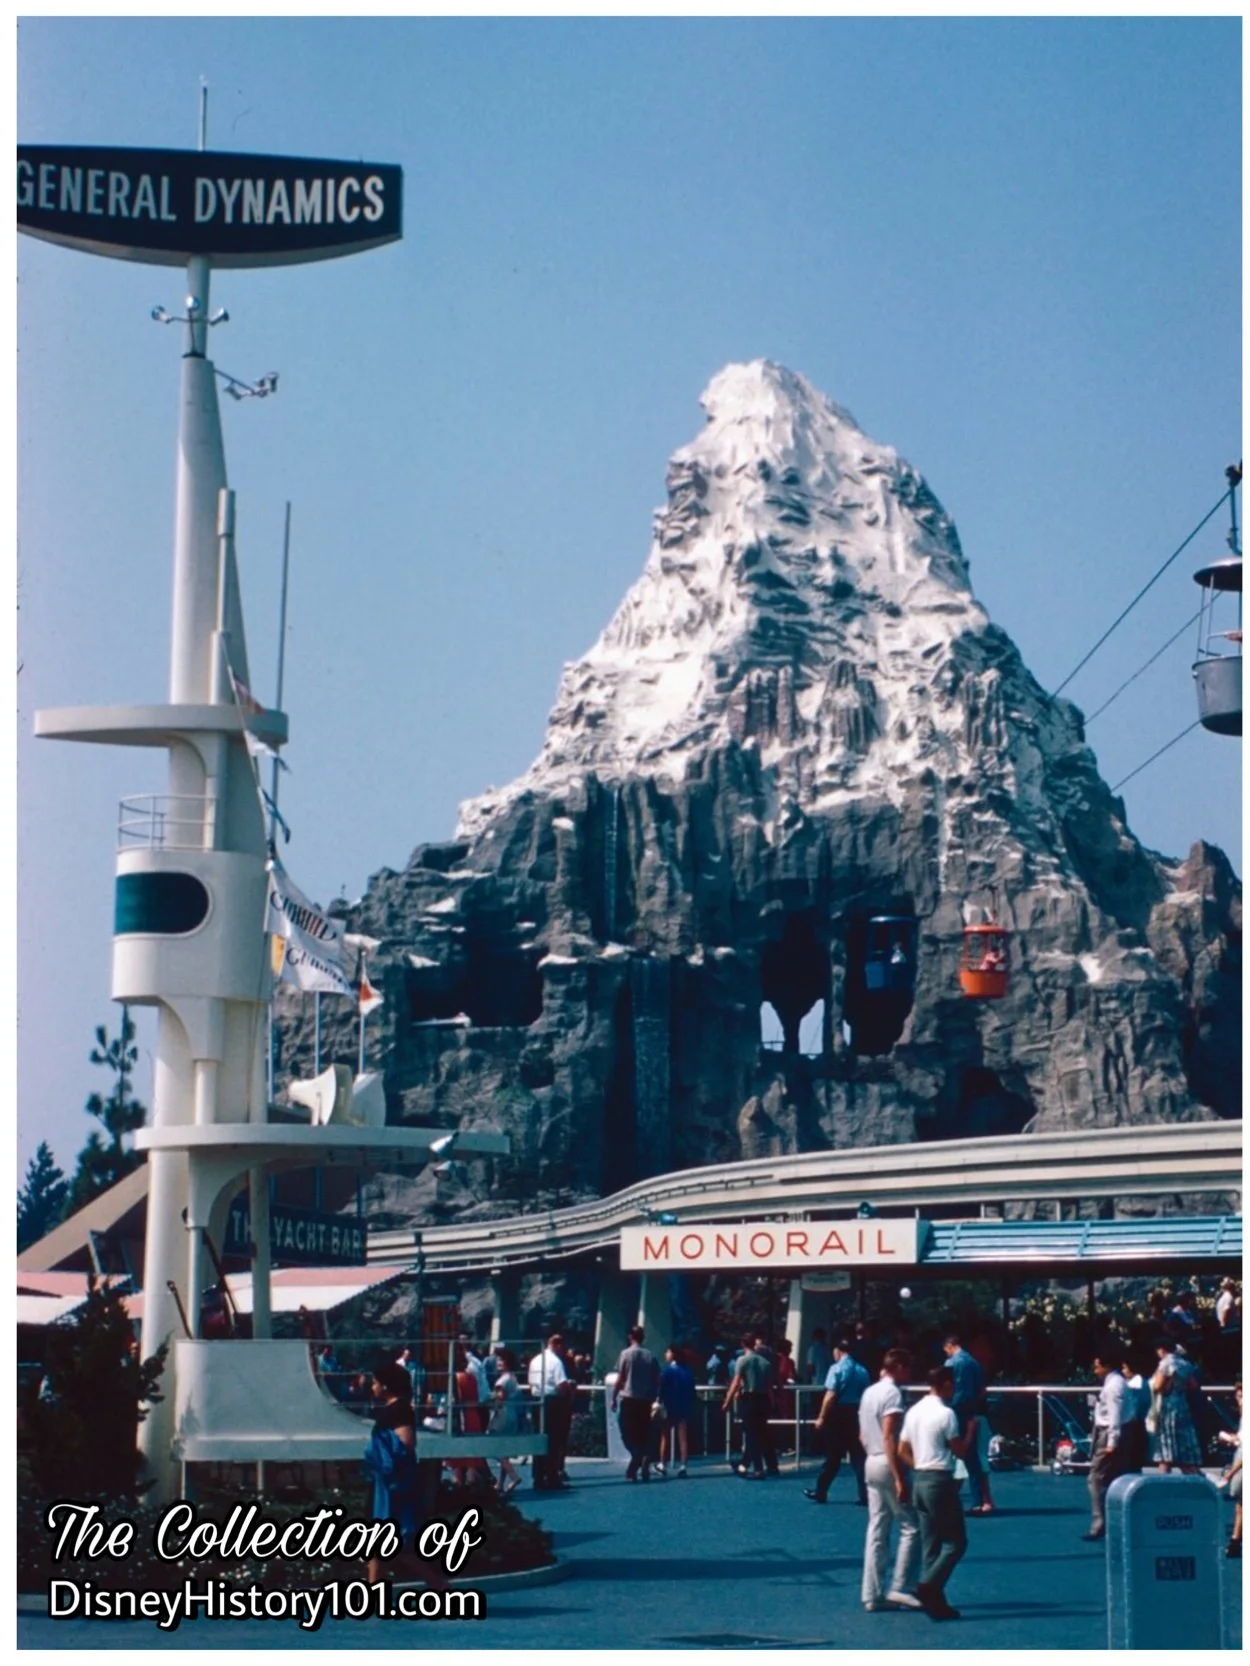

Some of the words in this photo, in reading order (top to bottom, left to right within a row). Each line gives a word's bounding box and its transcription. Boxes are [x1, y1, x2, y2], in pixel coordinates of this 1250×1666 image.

[17, 161, 177, 222] GENERAL
[195, 176, 385, 225] DYNAMICS
[232, 1210, 252, 1243] TH
[273, 1215, 326, 1252] YACHT
[331, 1225, 362, 1258] BAR
[643, 1229, 896, 1261] MONORAIL
[1157, 1516, 1191, 1529] PUSH
